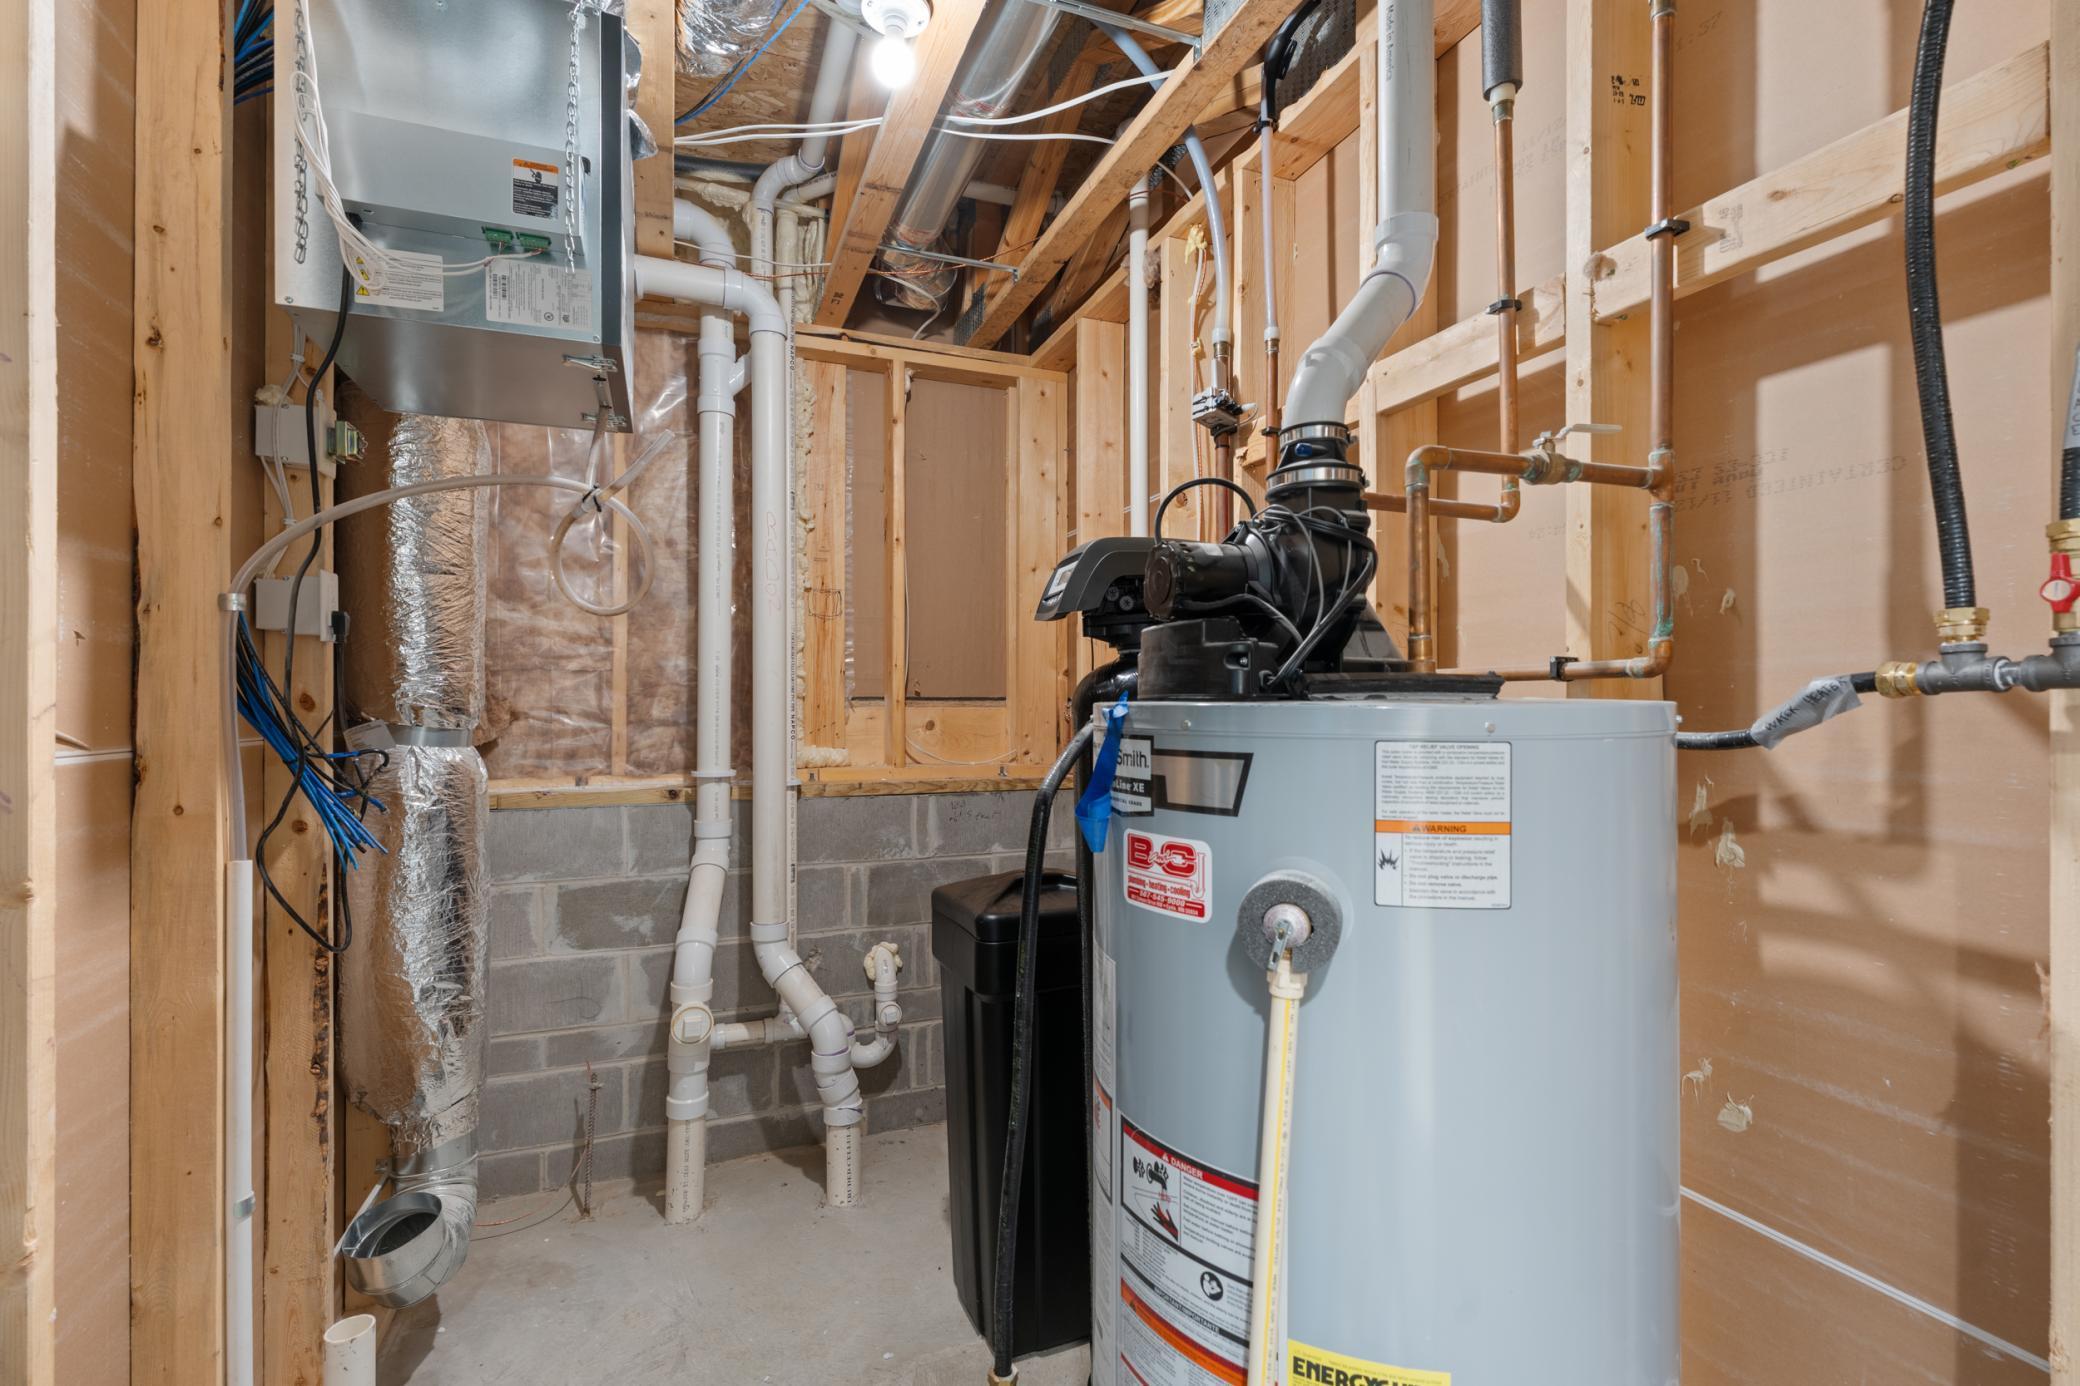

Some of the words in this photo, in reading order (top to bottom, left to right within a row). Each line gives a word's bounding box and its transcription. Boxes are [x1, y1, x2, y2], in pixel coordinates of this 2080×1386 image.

[764, 511, 783, 617] RADON
[1133, 782, 1144, 793] XE
[1422, 824, 1466, 833] WARNING
[1127, 833, 1153, 870] B
[1161, 841, 1197, 878] C
[1170, 886, 1191, 899] cooling
[1170, 1157, 1204, 1180] DANGER
